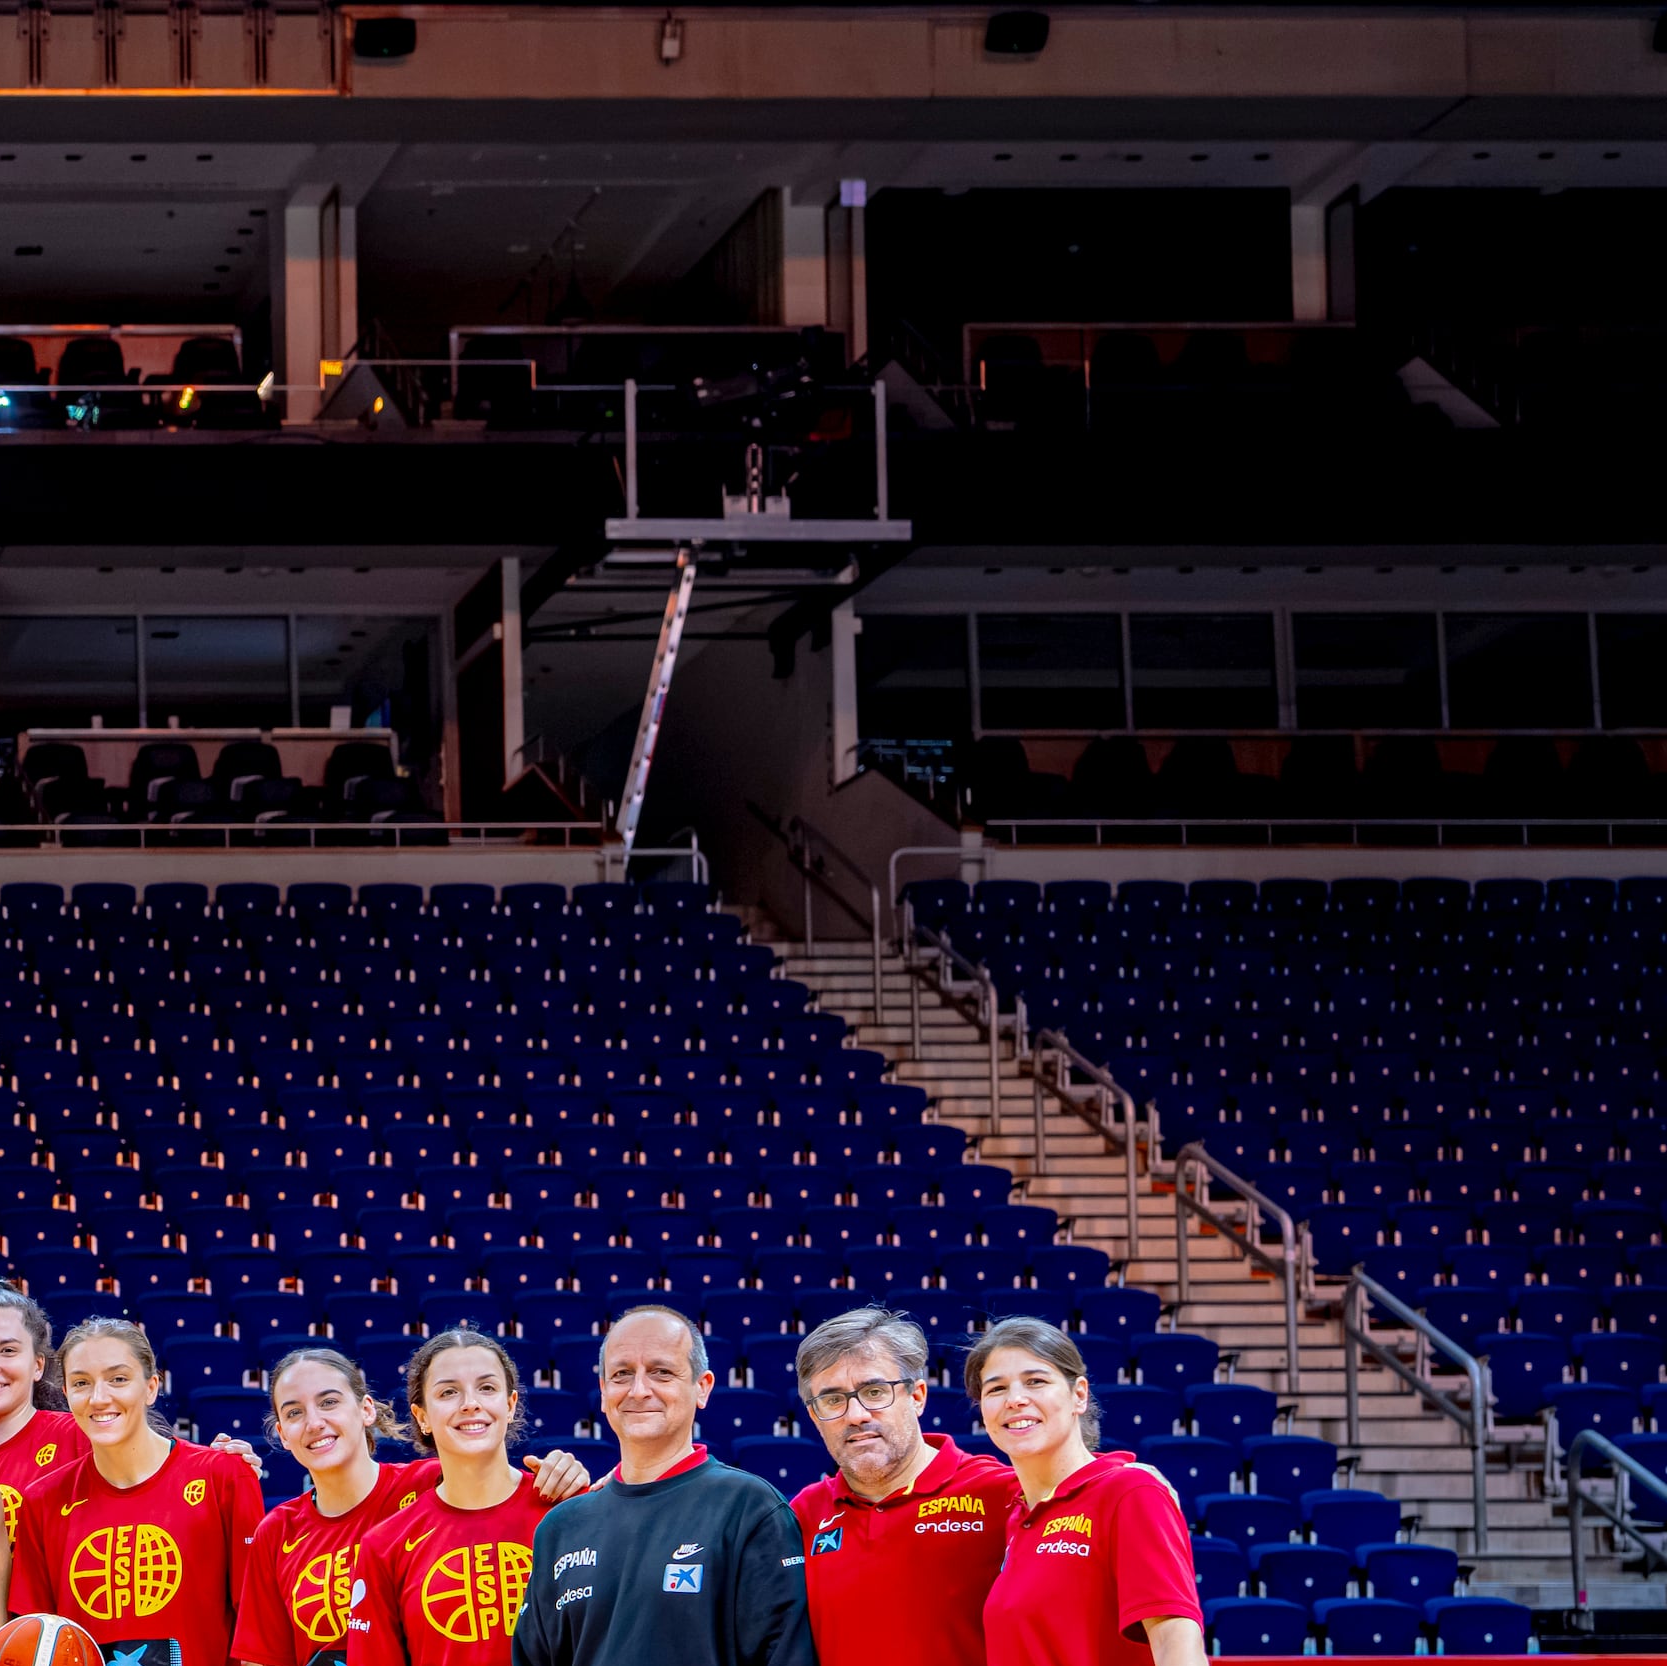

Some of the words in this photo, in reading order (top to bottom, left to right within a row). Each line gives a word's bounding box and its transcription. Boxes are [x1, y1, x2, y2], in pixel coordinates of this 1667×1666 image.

[918, 1494, 986, 1518] ESPAÑA
[914, 1519, 984, 1534] endesa
[1042, 1513, 1092, 1538] ESPAÑA
[1036, 1539, 1089, 1557] endesa
[553, 1546, 597, 1580] ESPAÑA
